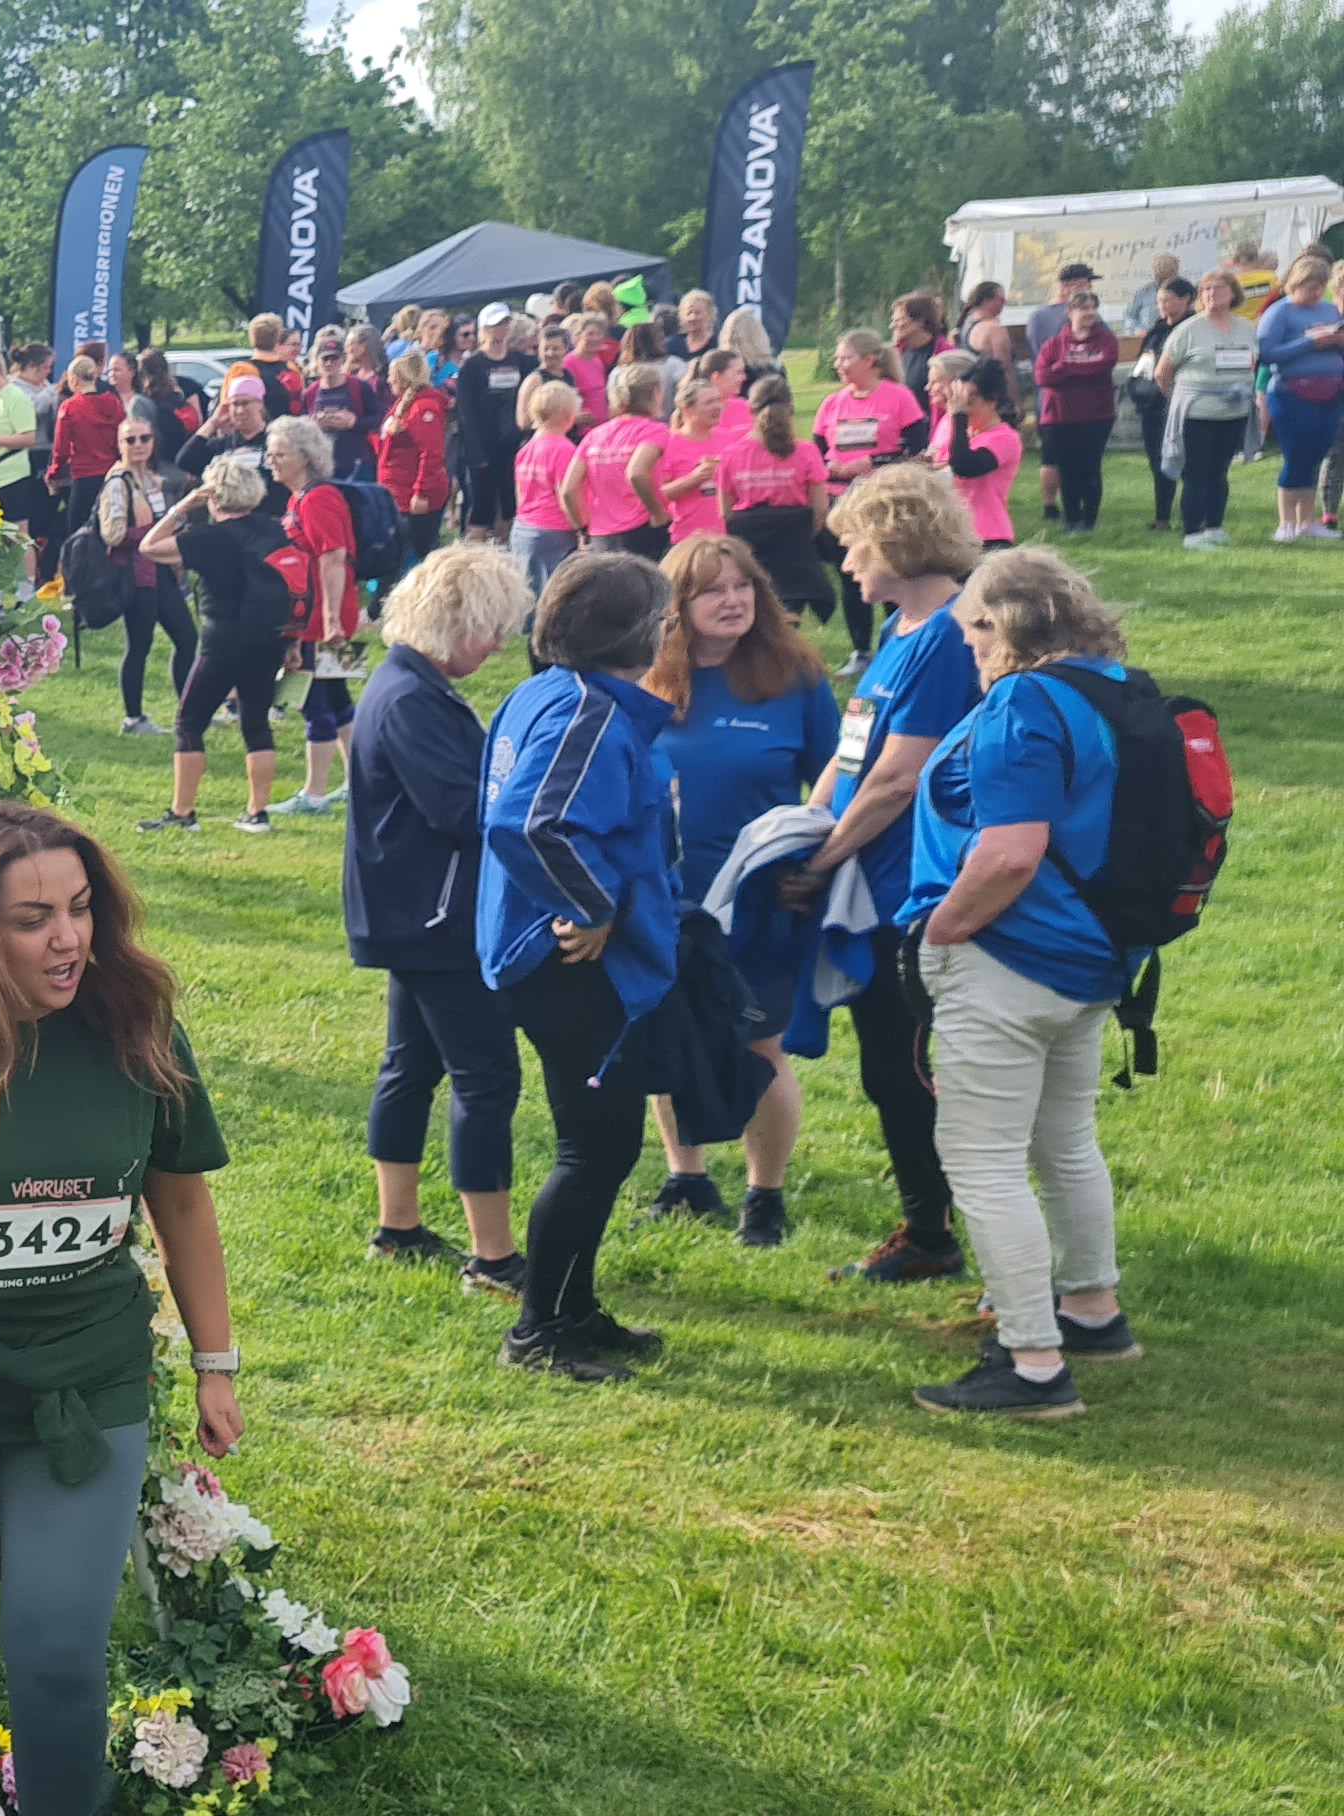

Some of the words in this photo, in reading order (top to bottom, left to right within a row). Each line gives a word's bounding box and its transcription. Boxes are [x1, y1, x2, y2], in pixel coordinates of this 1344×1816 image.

[92, 164, 126, 342] LANDSREGIONEN
[286, 167, 320, 353] ZANOVA
[736, 102, 782, 320] ZZANOVA
[11, 1176, 95, 1199] VÅRRUSET
[26, 1275, 47, 1286] FÖR
[50, 1272, 74, 1283] ALLA
